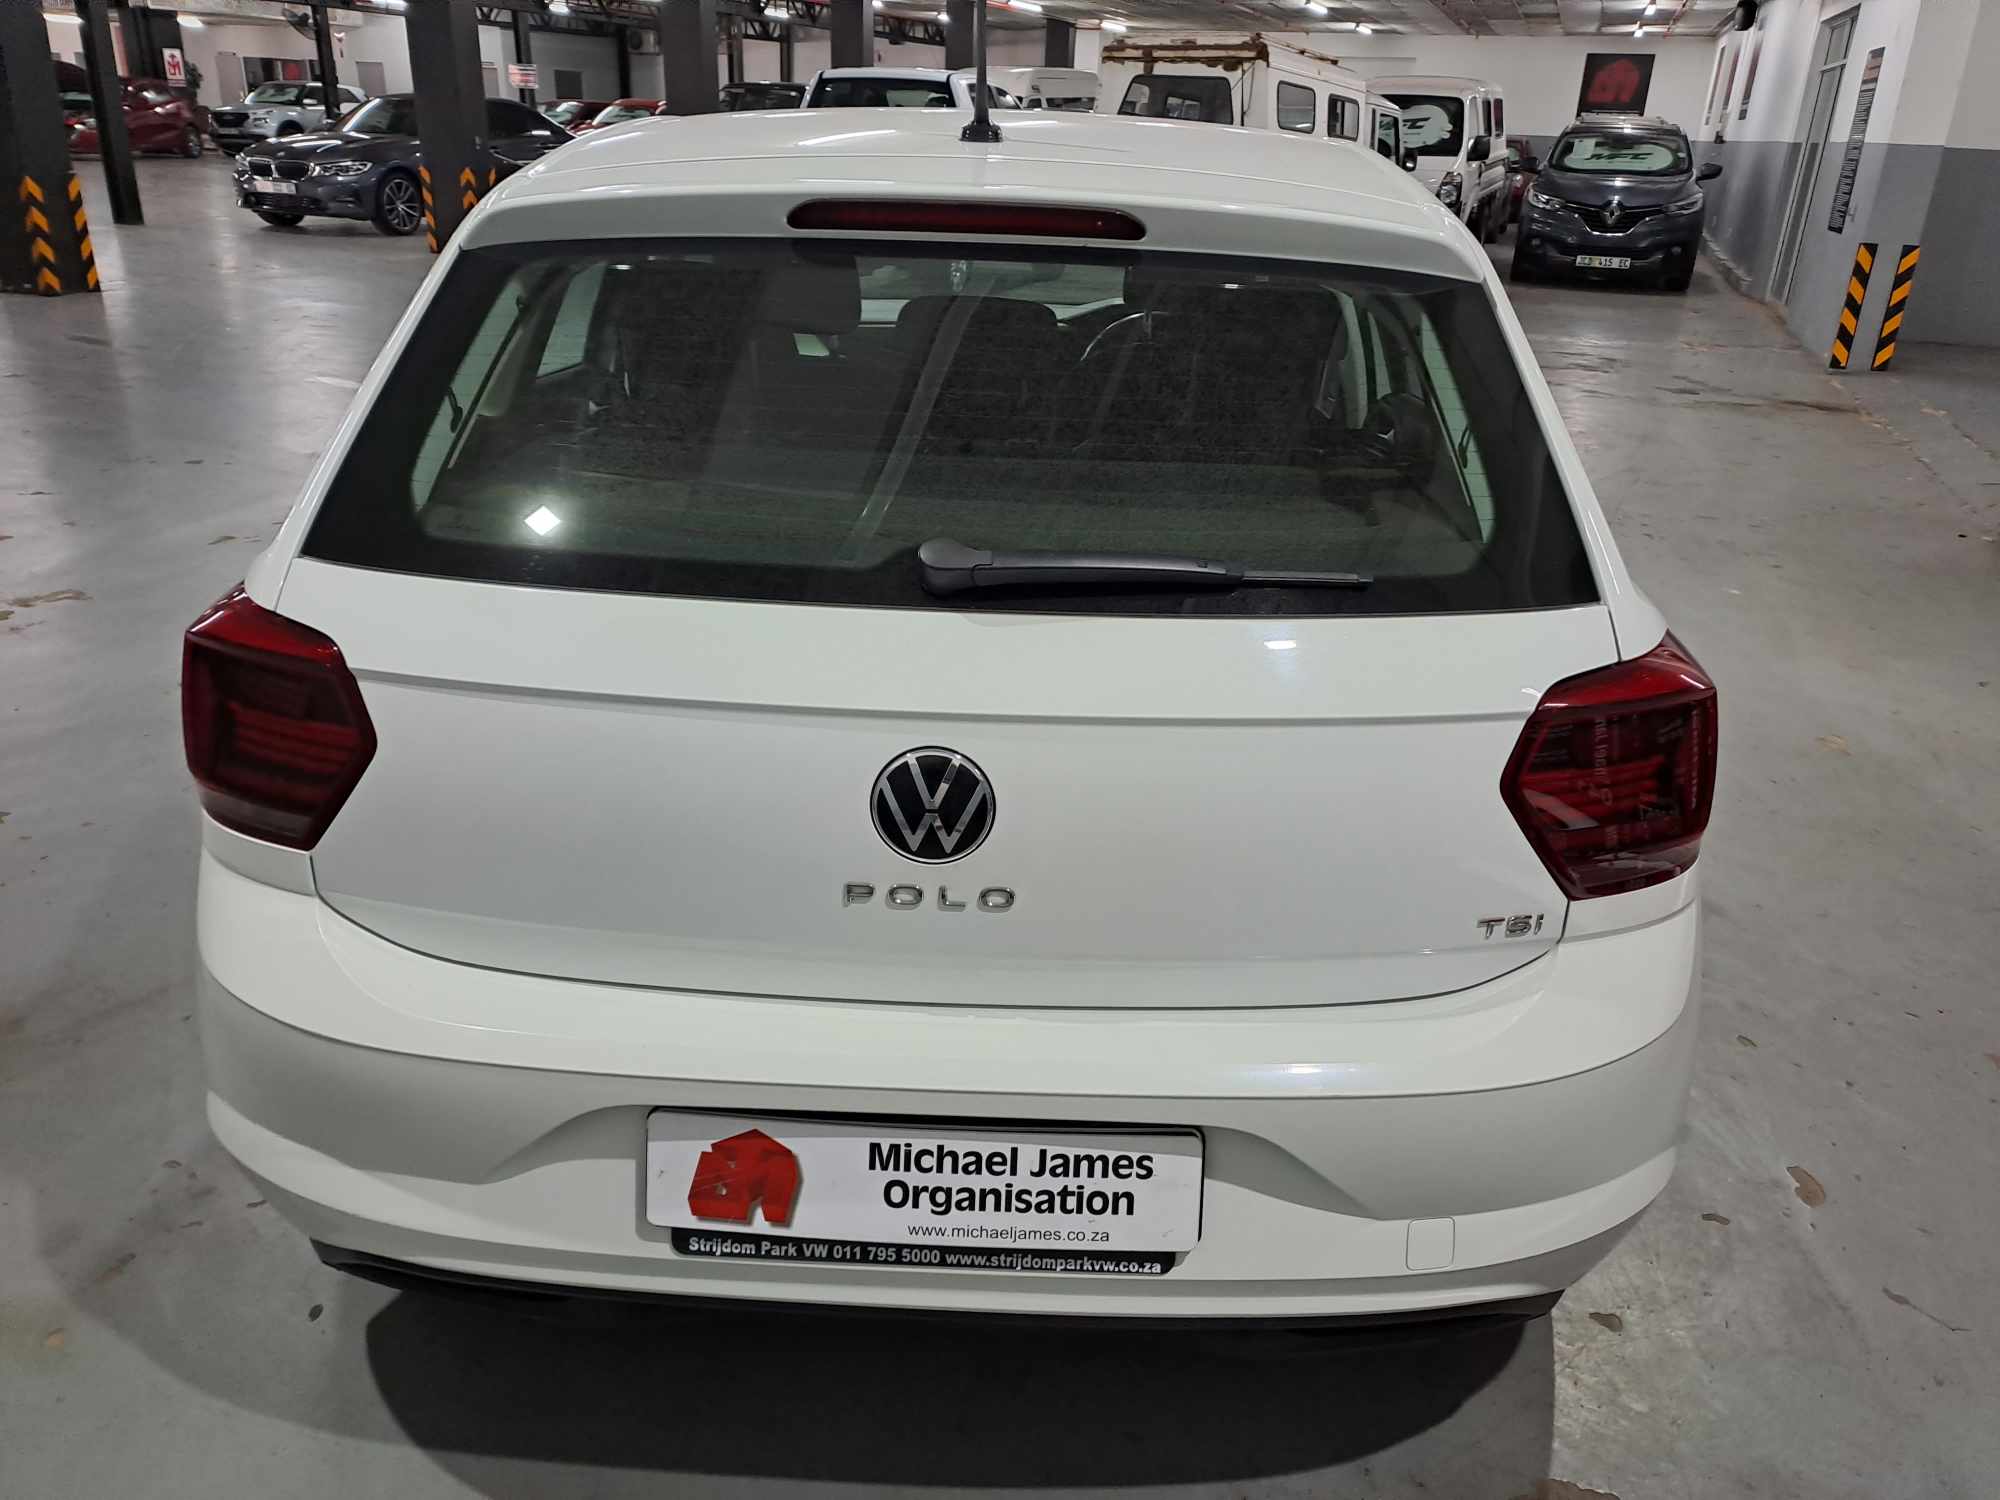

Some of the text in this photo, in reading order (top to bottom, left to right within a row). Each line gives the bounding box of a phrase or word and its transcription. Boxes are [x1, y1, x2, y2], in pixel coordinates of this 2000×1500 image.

[843, 882, 1016, 912] POLO
[868, 1142, 1154, 1180] Michael James
[883, 1179, 1135, 1216] Organisation
[907, 1224, 1110, 1243] www.michaeljames.co.za
[688, 1236, 1162, 1274] Strijdom Park VW 011 795 5000 www.strijdomparkvw.co.za
